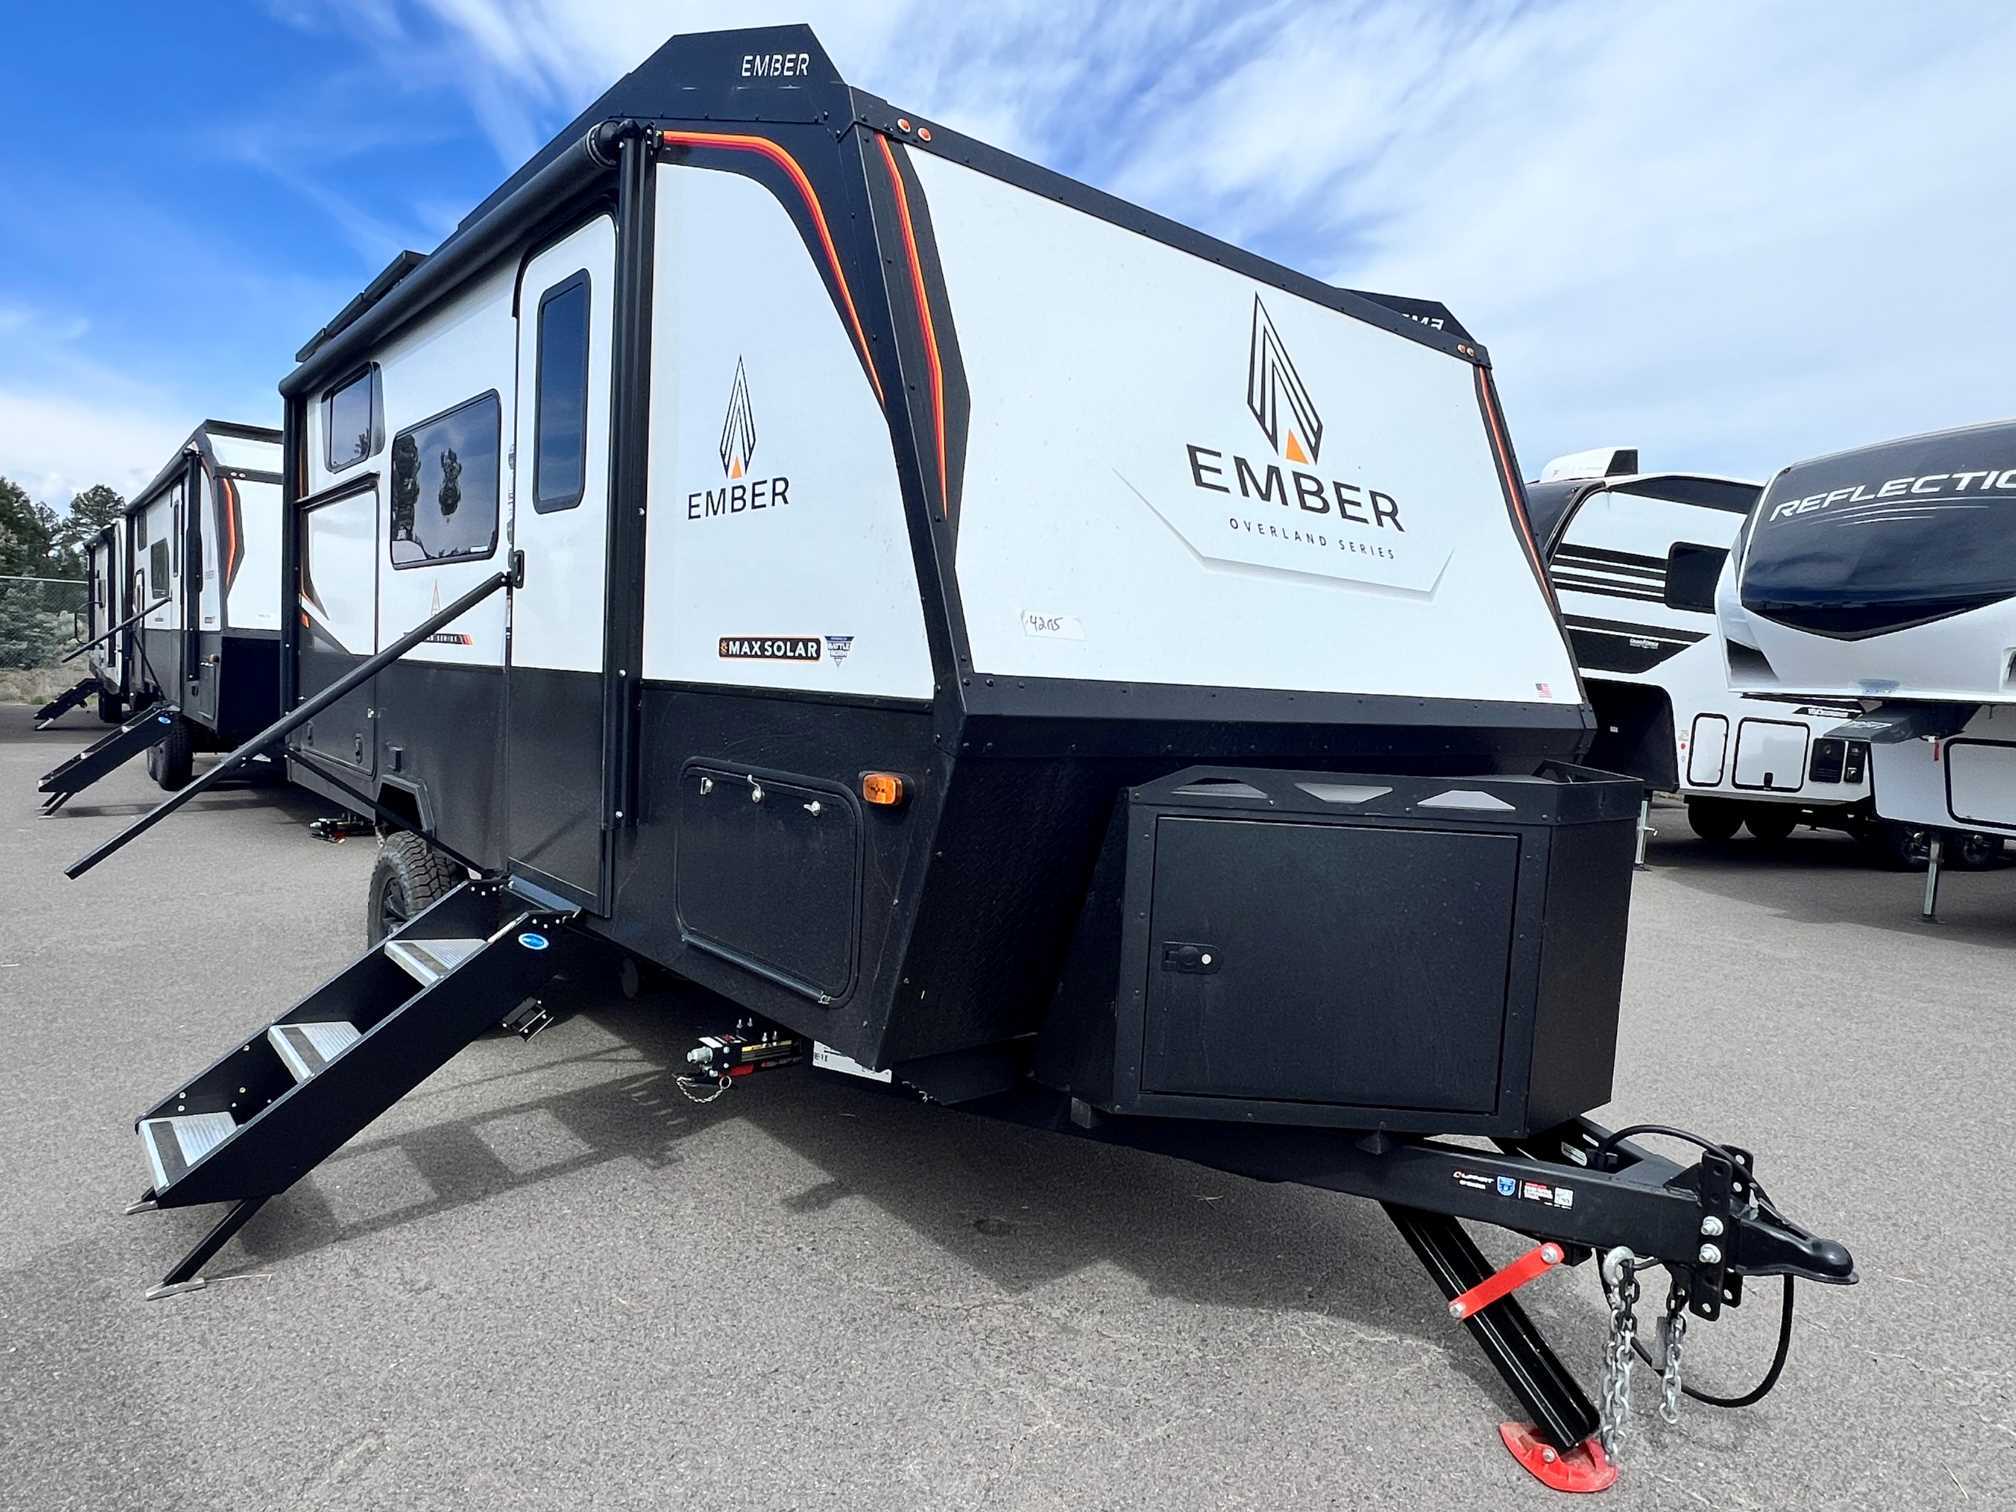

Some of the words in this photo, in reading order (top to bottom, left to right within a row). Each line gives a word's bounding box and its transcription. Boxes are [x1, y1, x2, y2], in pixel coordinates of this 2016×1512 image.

[741, 53, 810, 77] EMBER
[687, 476, 790, 520] EMBER
[1186, 443, 1406, 533] EMBER
[1229, 517, 1328, 547] OVERLAND
[1338, 538, 1395, 560] SERIES
[728, 640, 762, 656] MAX
[764, 641, 818, 658] SOLAR
